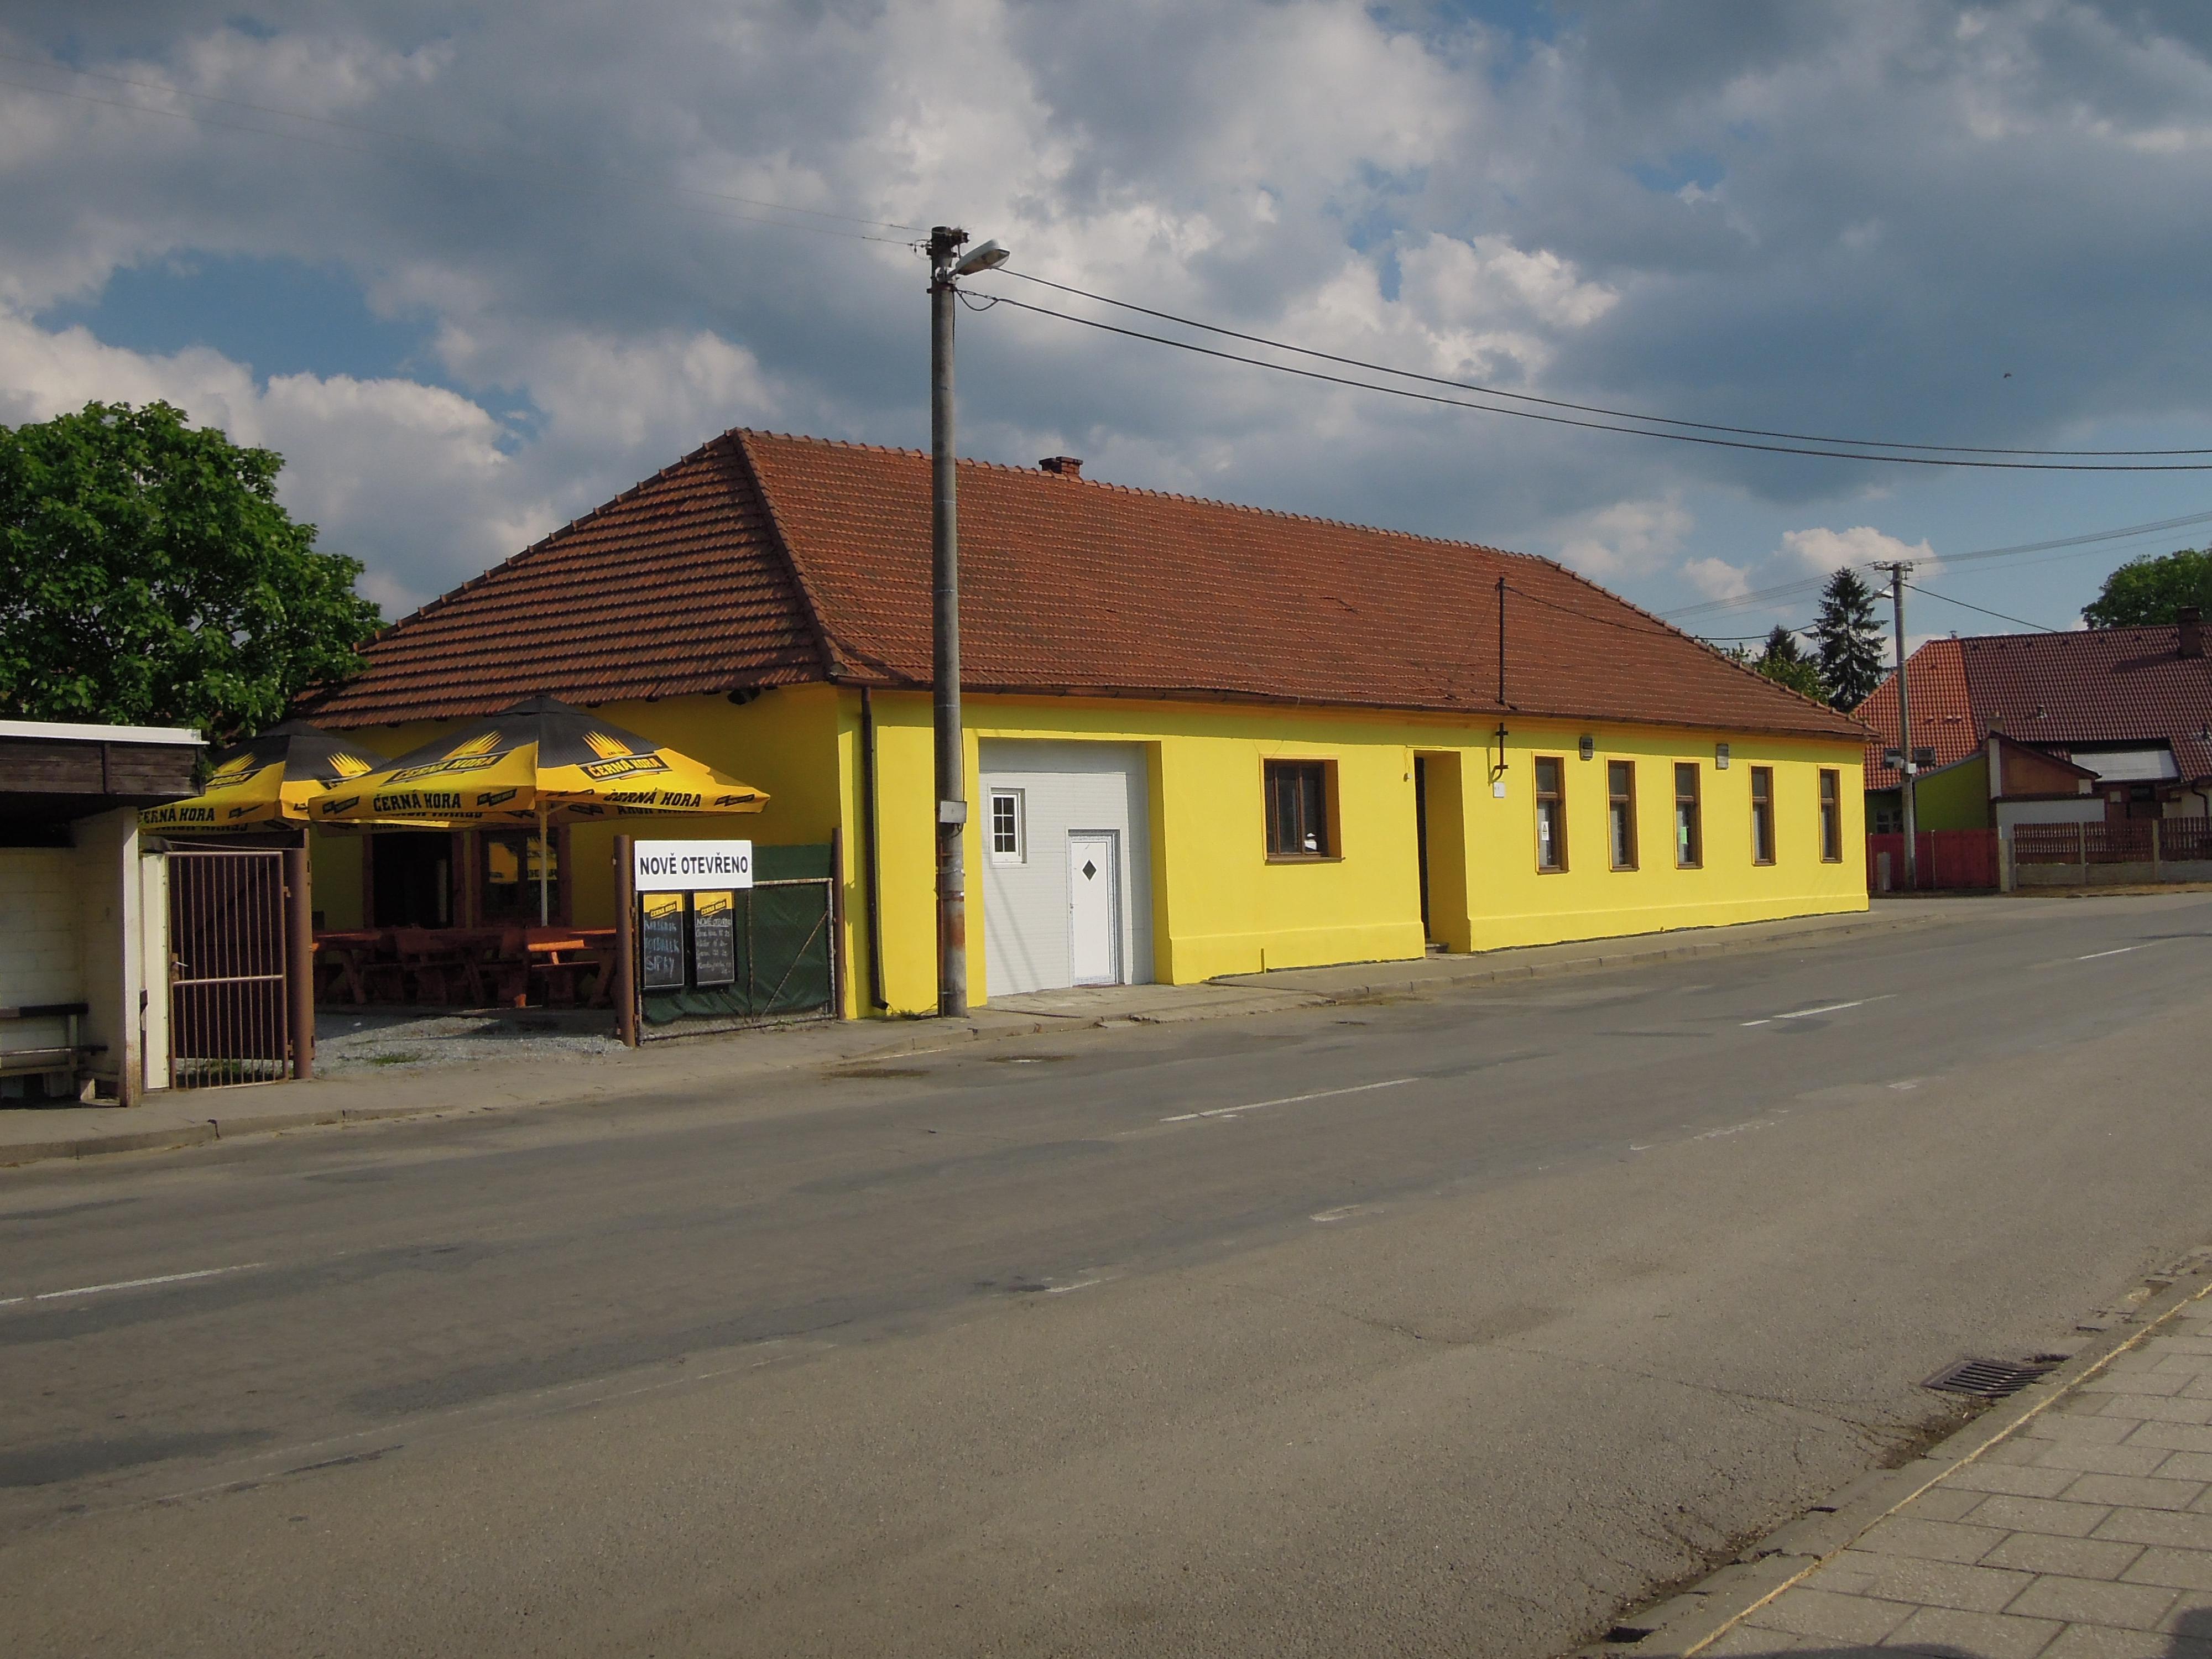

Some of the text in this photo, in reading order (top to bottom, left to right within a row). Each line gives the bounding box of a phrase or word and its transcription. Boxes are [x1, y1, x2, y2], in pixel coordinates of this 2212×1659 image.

[446, 756, 498, 769] HORA
[588, 758, 662, 777] ČERNÁ HORA
[373, 789, 422, 812] ČERNÁ
[424, 793, 462, 808] HORA
[603, 787, 658, 805] ČERNÁ
[660, 792, 701, 807] HORA
[179, 808, 215, 822] HORA
[640, 852, 748, 875] NOVĚ OTEVŘENO
